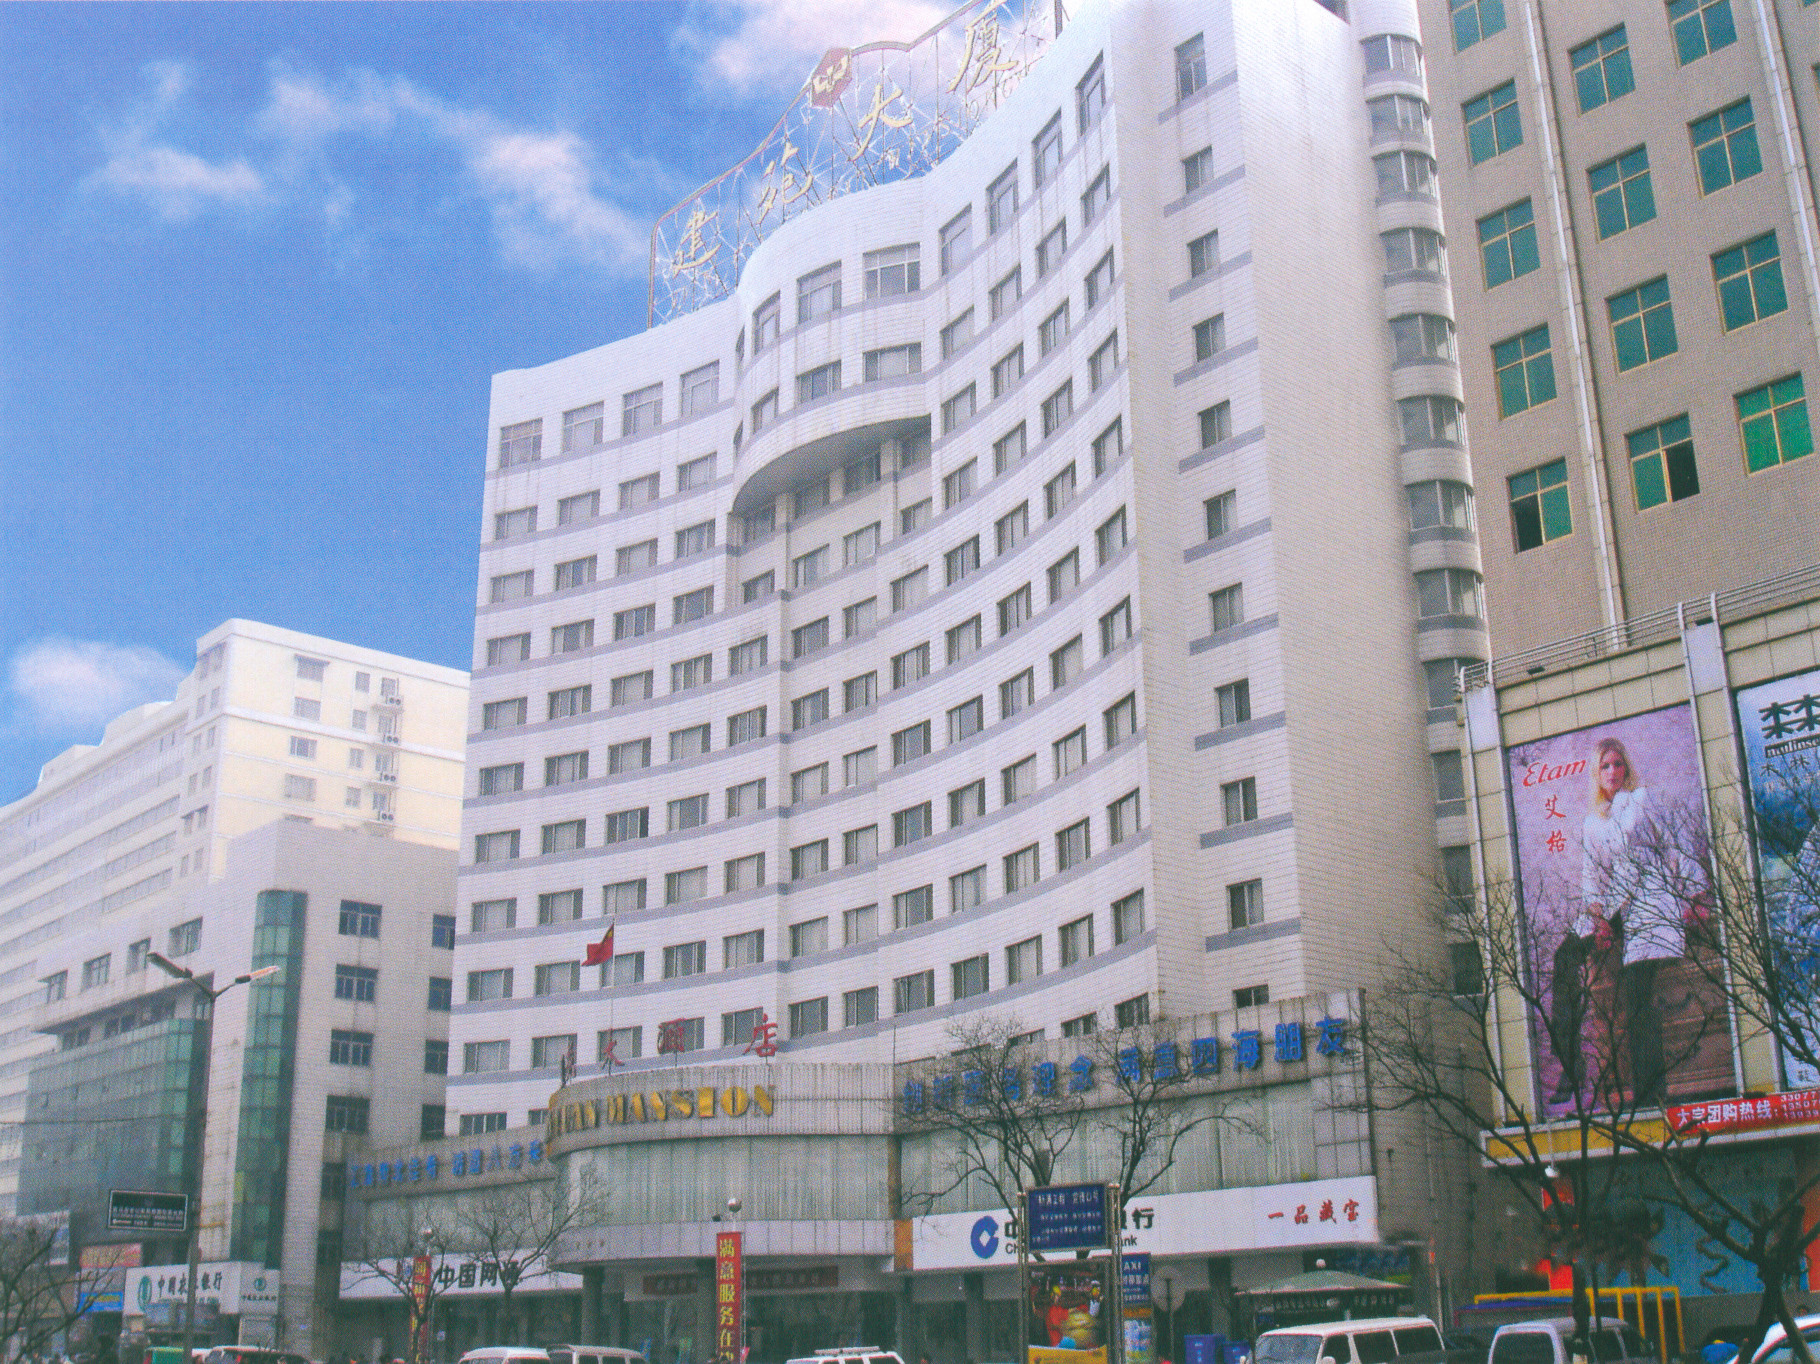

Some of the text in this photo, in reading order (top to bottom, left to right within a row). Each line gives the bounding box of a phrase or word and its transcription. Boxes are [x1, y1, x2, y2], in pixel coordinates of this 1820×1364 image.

[1523, 759, 1586, 787] Etam
[1545, 793, 1567, 854] 艾格
[607, 1085, 775, 1125] MANSION
[1268, 1199, 1359, 1225] 一品藏宝
[1123, 1261, 1142, 1272] AXI
[157, 1271, 223, 1298] 中国农银行
